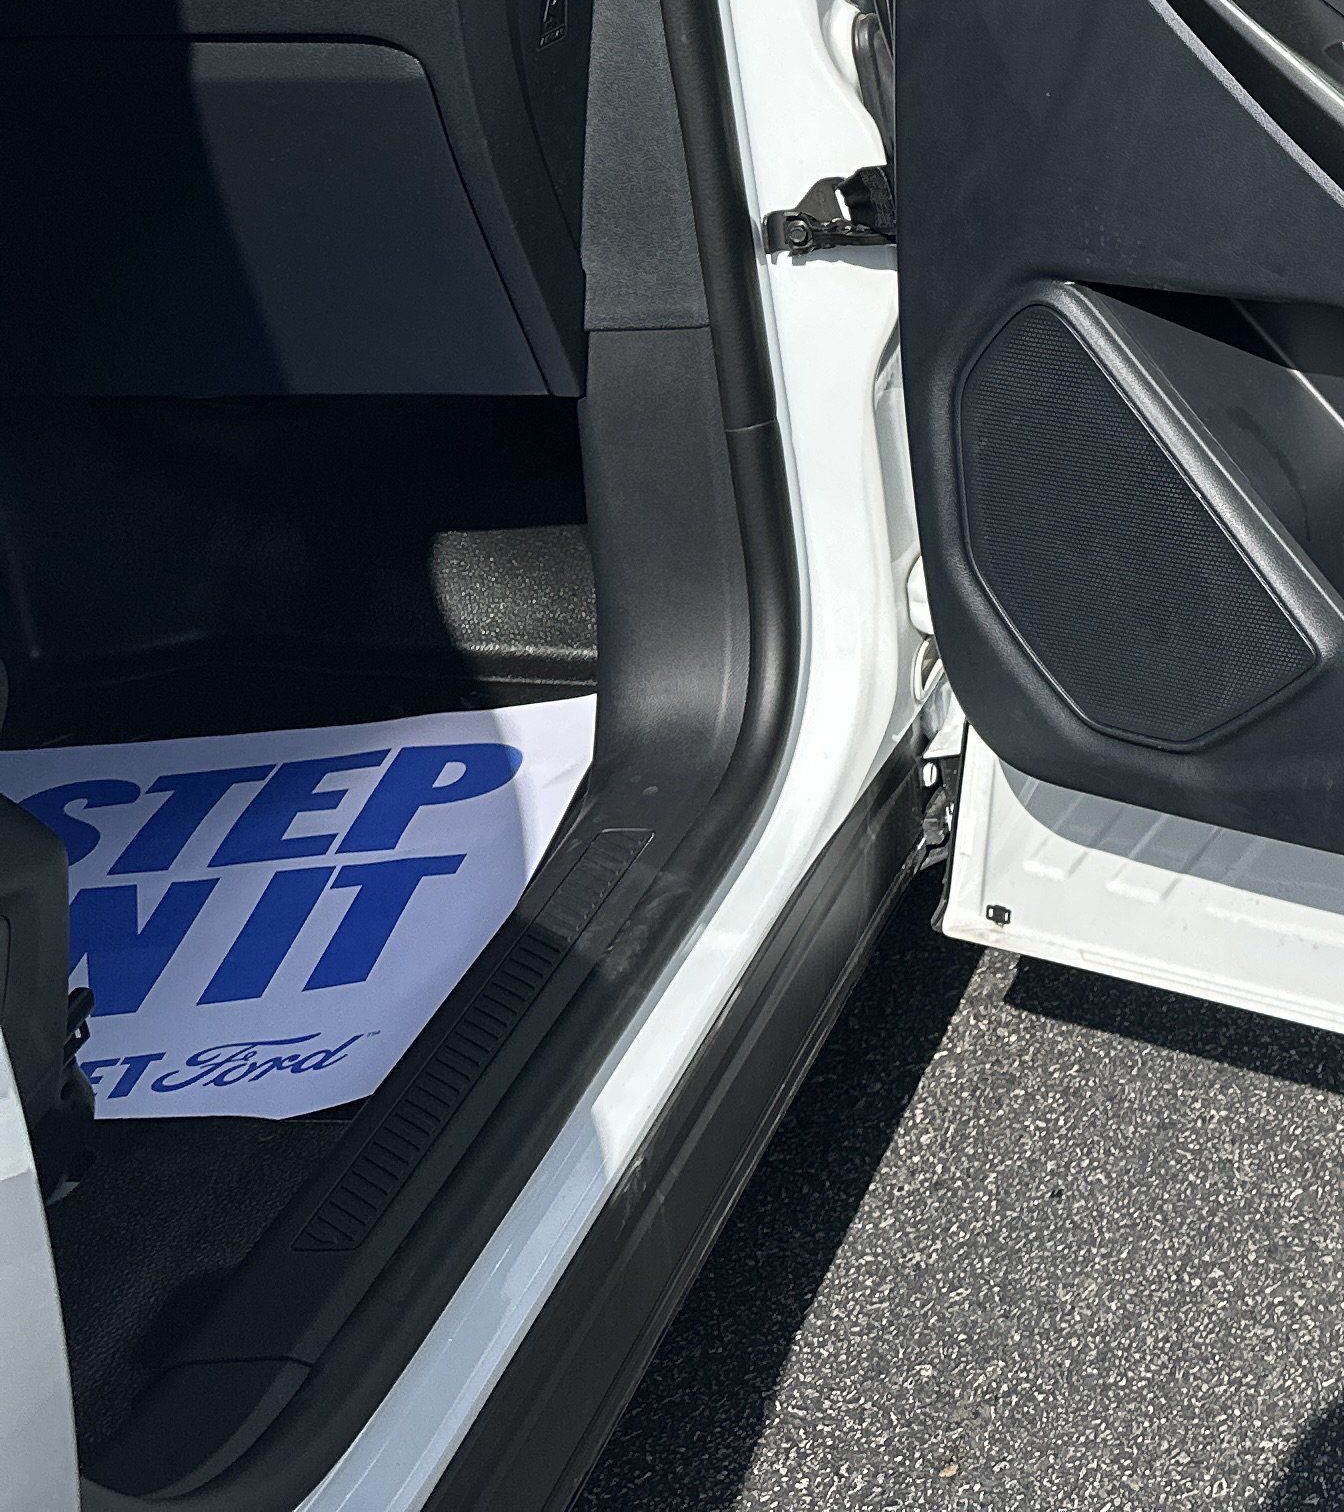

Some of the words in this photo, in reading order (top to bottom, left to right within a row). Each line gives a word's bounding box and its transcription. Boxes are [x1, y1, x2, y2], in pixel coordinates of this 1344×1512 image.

[18, 742, 524, 876] STEP
[196, 853, 468, 1006] IT
[86, 1052, 166, 1100] ET
[151, 1031, 364, 1094] Ford
